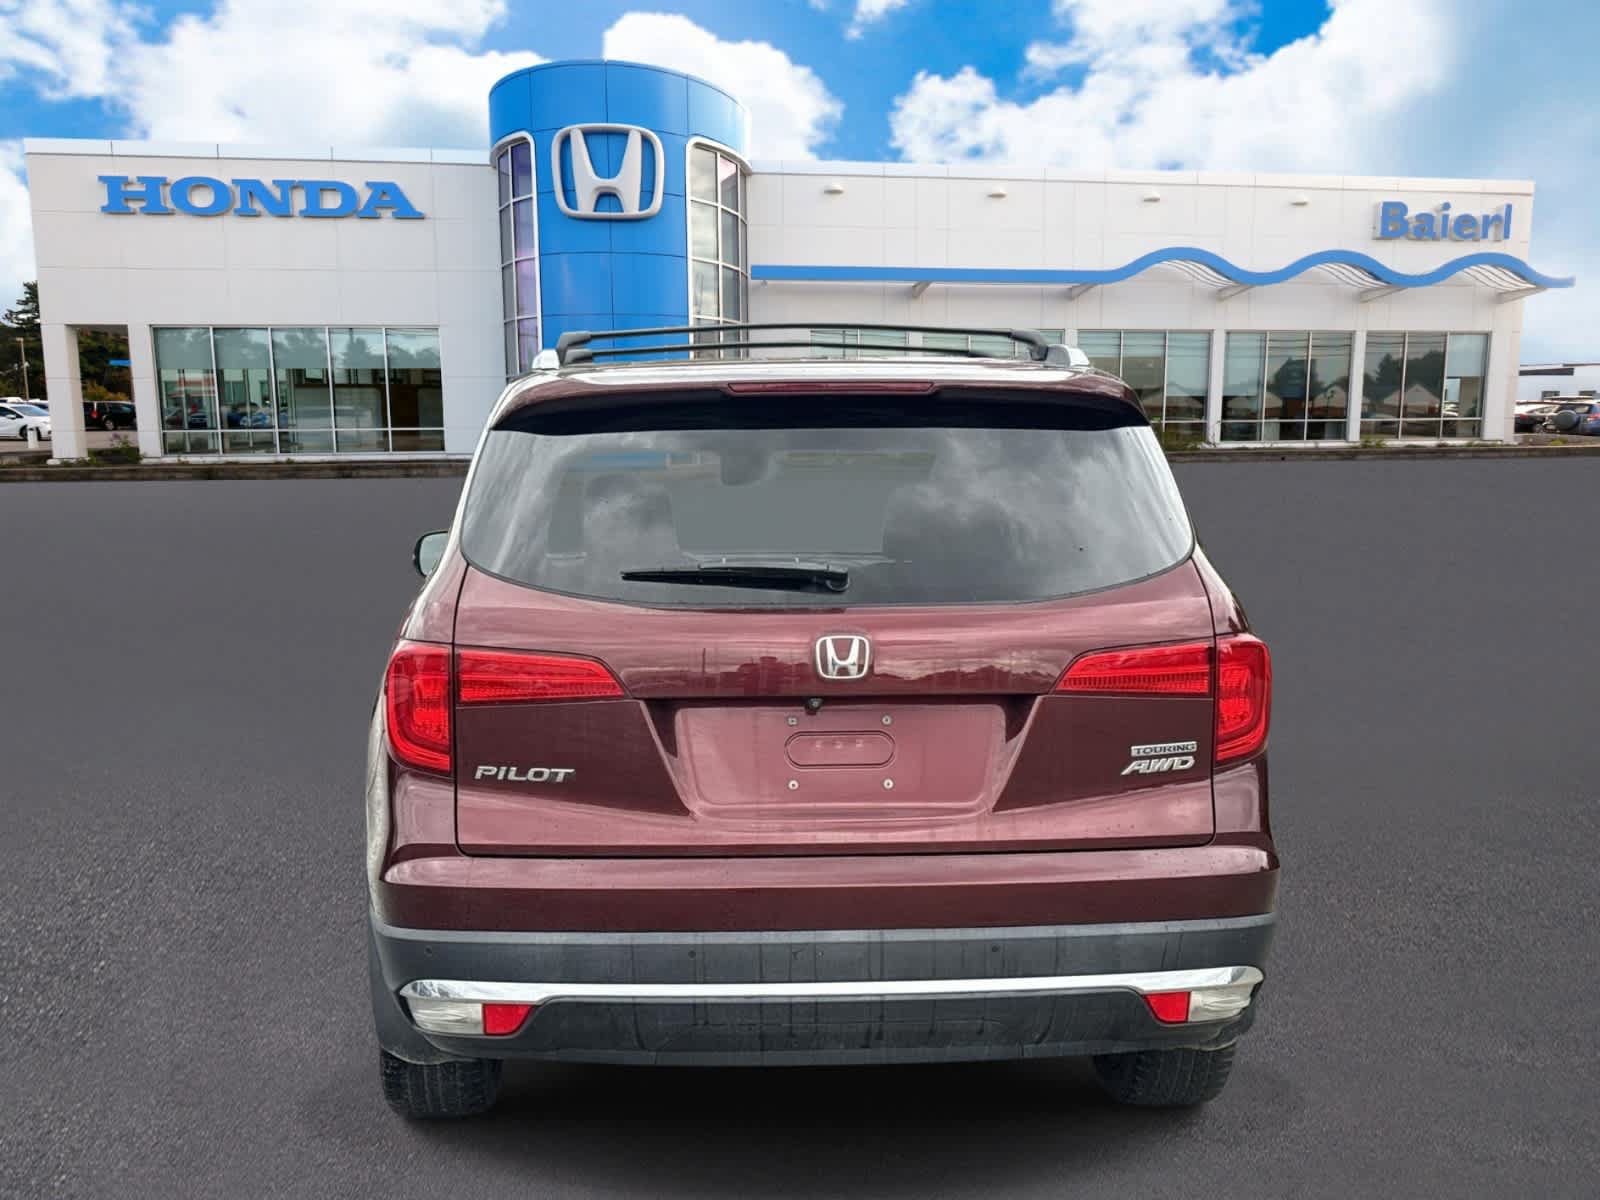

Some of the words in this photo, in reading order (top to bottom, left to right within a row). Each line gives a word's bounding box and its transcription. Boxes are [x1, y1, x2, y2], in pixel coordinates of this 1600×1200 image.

[99, 175, 425, 219] HONDA
[1377, 201, 1513, 240] Baierl
[1133, 743, 1195, 755] TOURING
[474, 765, 576, 783] PILOT
[1121, 755, 1195, 776] AWD
